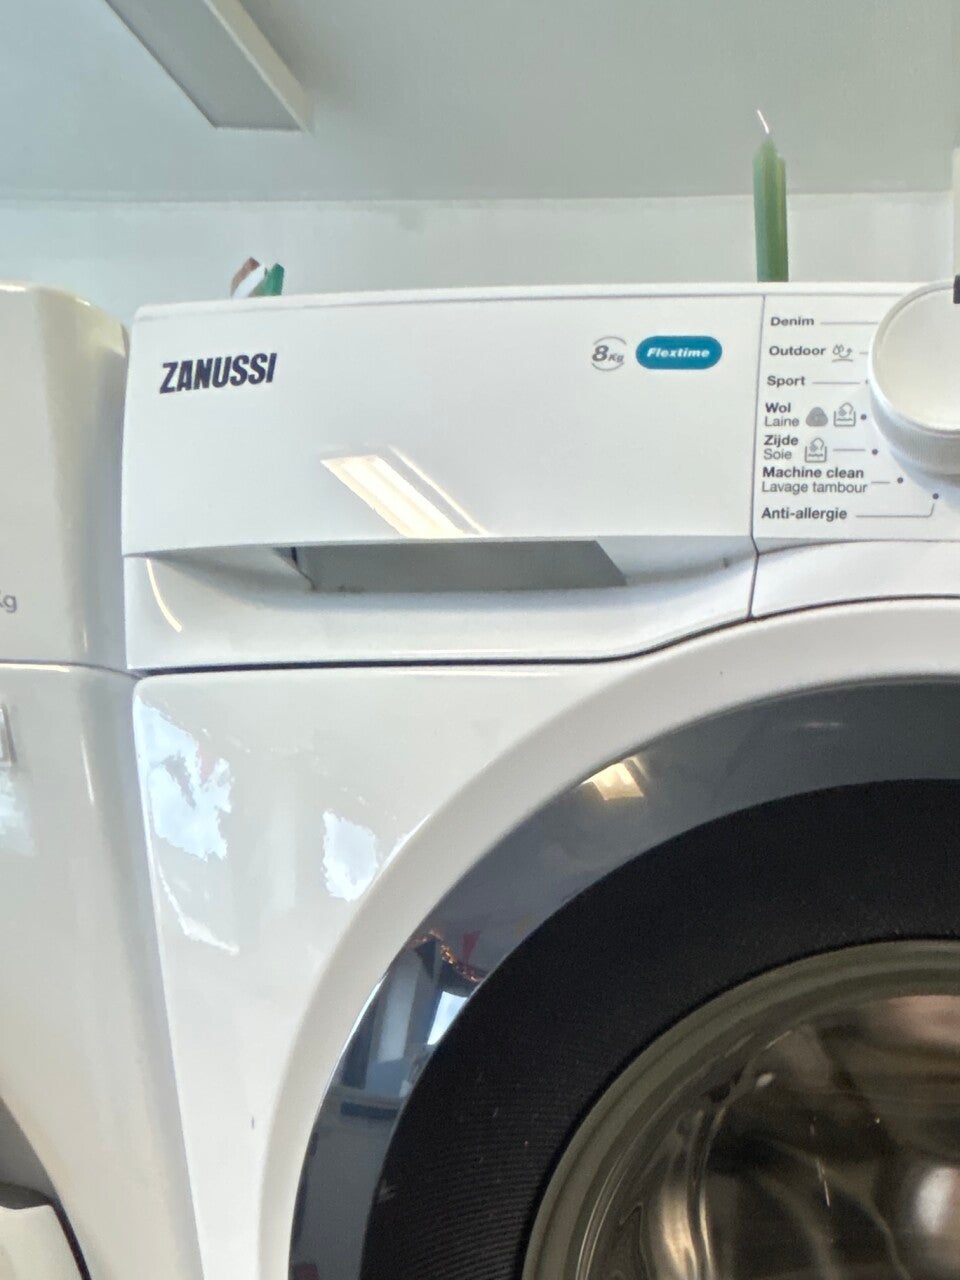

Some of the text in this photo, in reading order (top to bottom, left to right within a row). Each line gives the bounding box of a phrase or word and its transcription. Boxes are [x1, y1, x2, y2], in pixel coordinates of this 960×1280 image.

[771, 317, 815, 327] Denim
[646, 346, 711, 358] Flextime
[769, 345, 827, 356] Outdoor
[159, 353, 278, 395] ZANUSSI
[767, 375, 806, 388] Sport
[765, 402, 792, 414] Wol
[764, 416, 800, 428] Laine
[763, 434, 799, 448] Zijde
[763, 448, 793, 460] Soie
[763, 466, 864, 479] Machine clean
[762, 481, 868, 493] Lavage tambour
[761, 507, 848, 522] Anti-allergie
